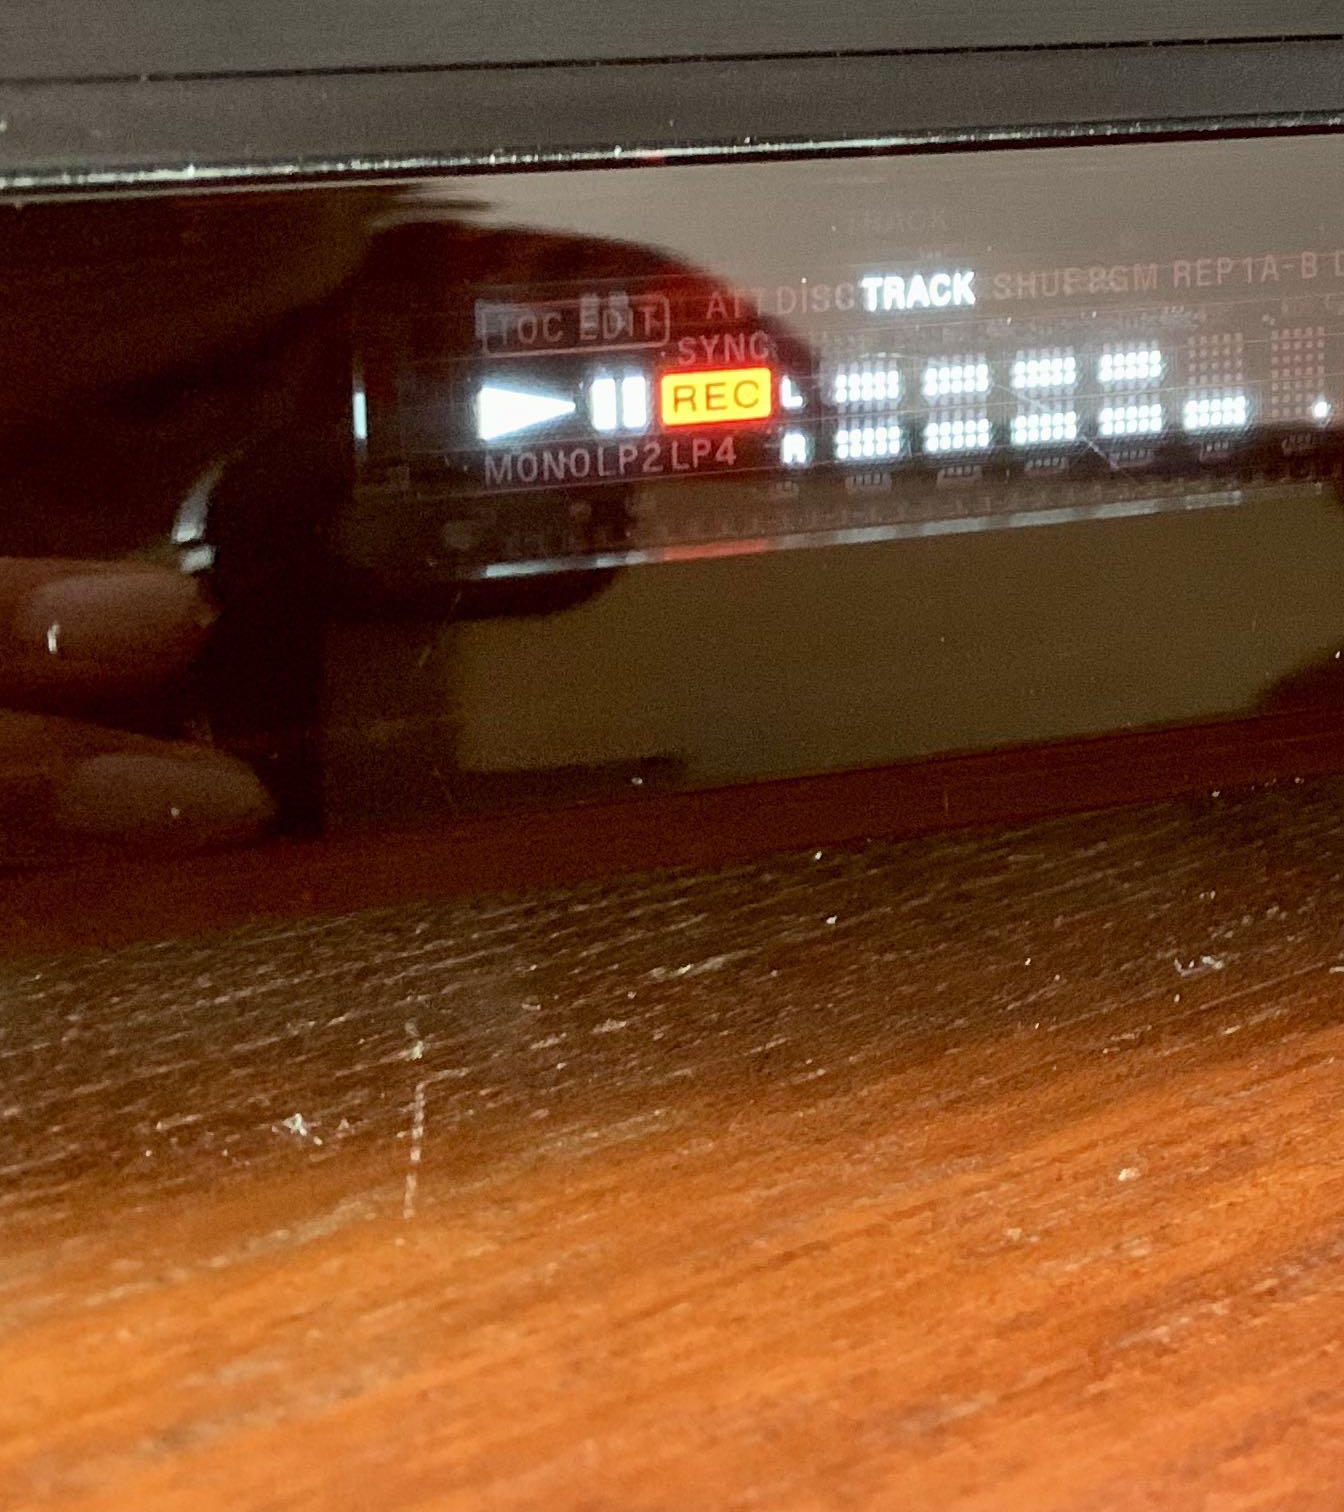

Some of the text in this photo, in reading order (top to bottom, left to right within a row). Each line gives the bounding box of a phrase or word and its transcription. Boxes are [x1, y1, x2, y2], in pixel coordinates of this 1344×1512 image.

[860, 270, 976, 312] TRACK
[678, 330, 770, 365] SYNC
[672, 380, 760, 414] REC
[484, 446, 591, 485] MONO
